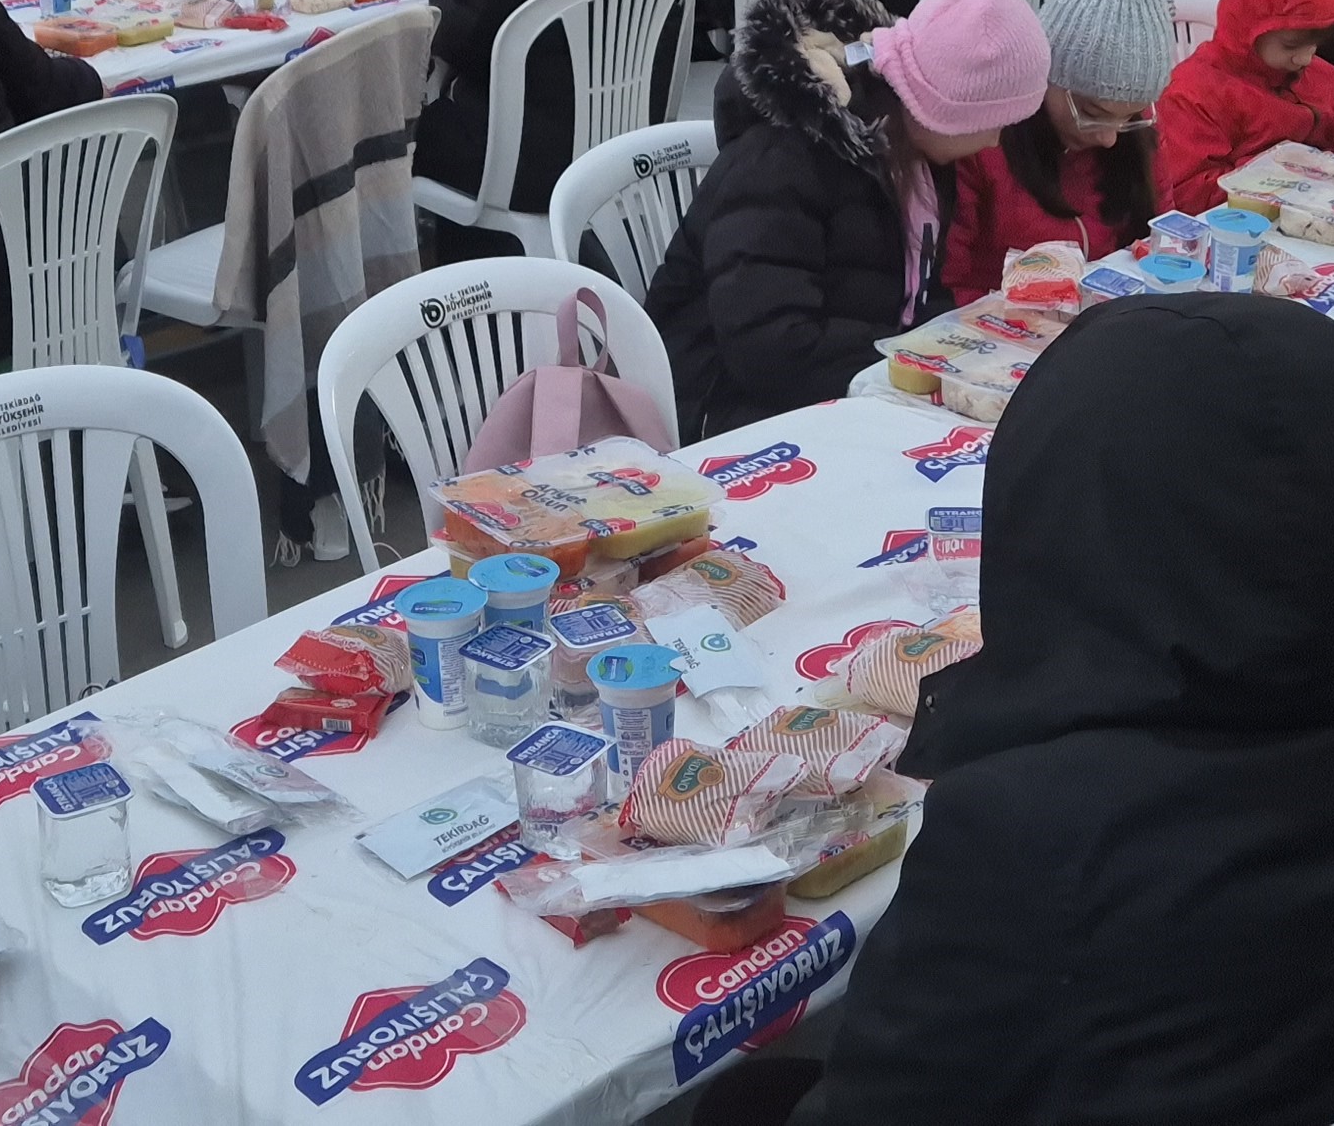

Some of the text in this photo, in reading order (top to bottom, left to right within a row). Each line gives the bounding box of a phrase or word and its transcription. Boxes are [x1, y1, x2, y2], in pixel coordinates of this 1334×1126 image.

[714, 447, 792, 484] ÇALIŞIYO
[521, 489, 569, 513] Olsun
[433, 814, 490, 849] TEKİRDAĞ
[94, 838, 271, 934] ÇALIŞIYORUZ
[148, 862, 261, 918] Candan
[440, 841, 526, 895] ÇALIŞI
[695, 929, 804, 1000] Candan
[684, 928, 845, 1064] ÇALIŞIYORUZ
[308, 970, 494, 1090] ÇALIŞIYORUZ
[366, 1002, 488, 1071] Candan
